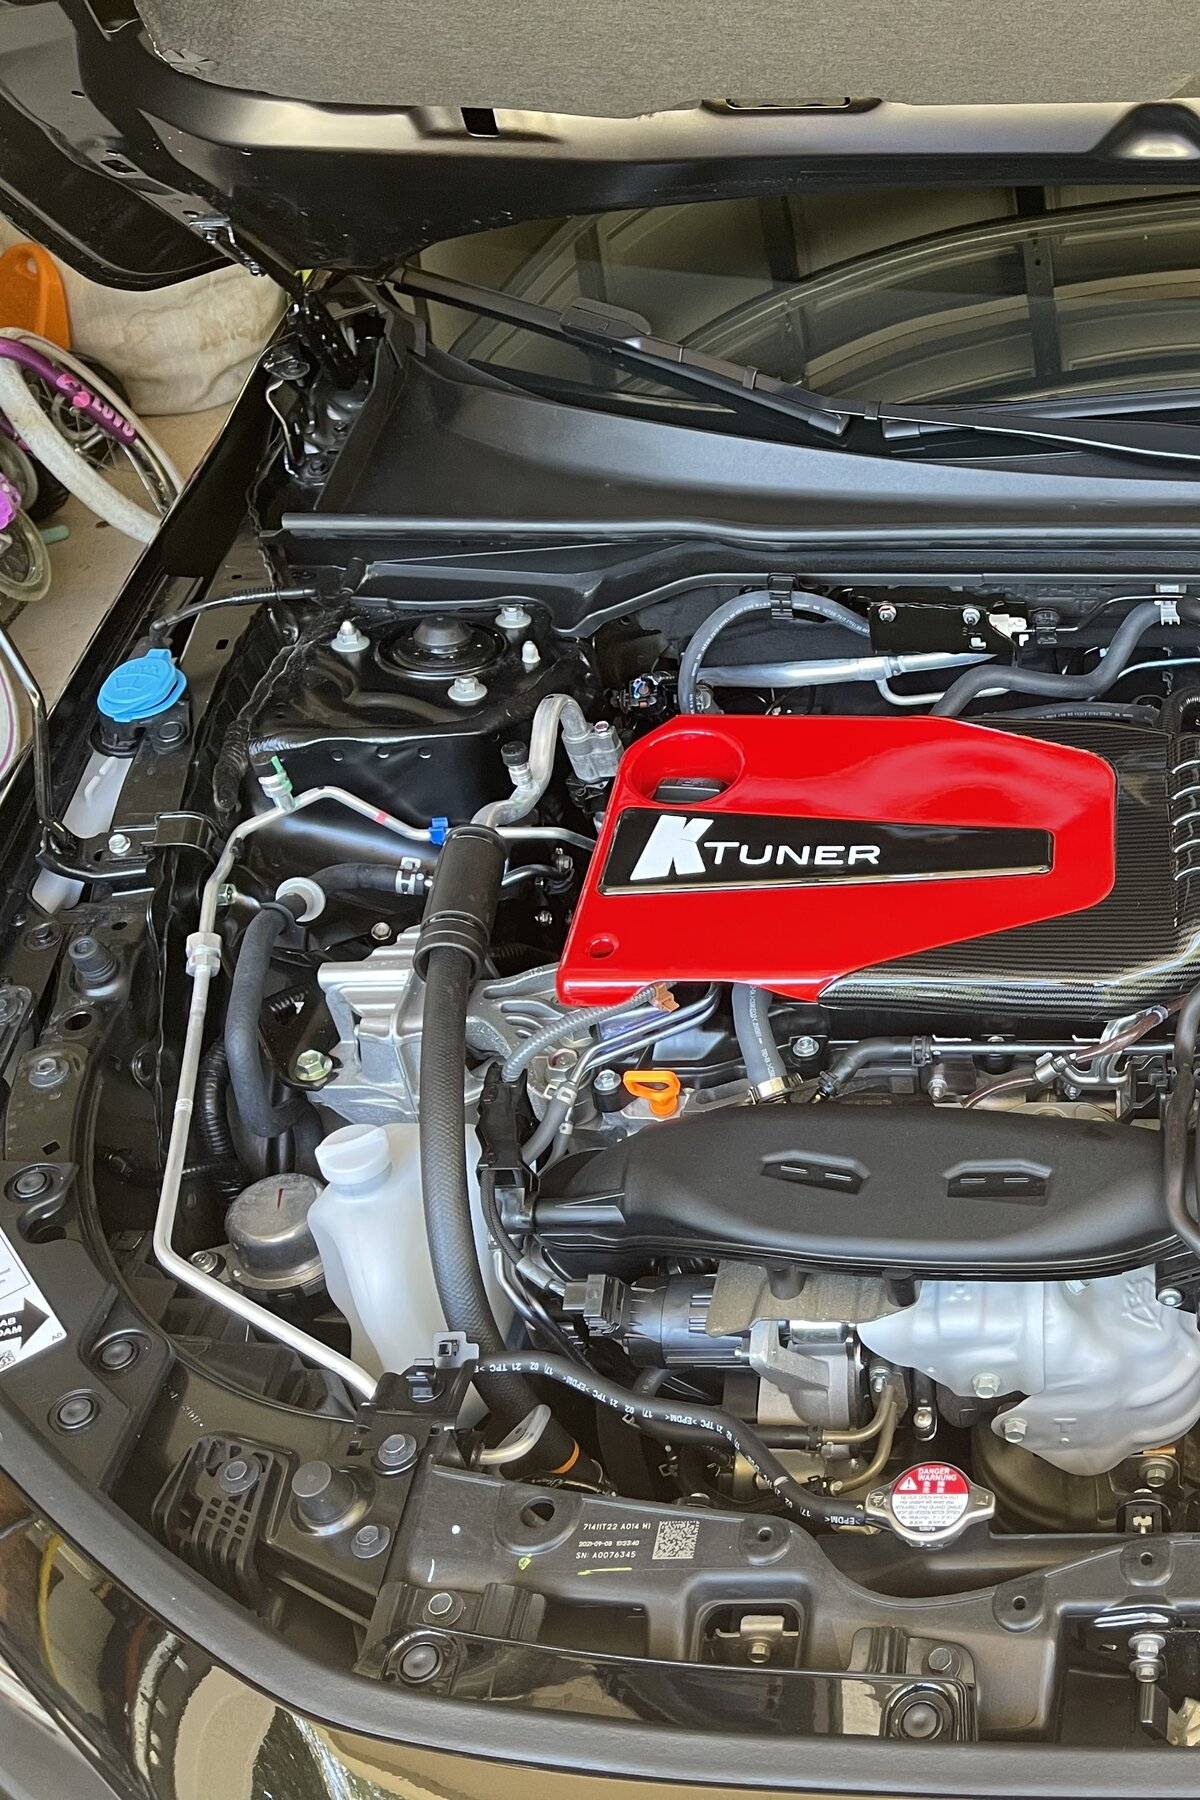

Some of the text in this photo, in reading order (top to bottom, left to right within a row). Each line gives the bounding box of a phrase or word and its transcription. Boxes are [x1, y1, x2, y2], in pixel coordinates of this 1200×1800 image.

[630, 814, 881, 881] KTUNER
[489, 1363, 508, 1372] TPC
[918, 1467, 951, 1475] DANGER
[592, 1551, 637, 1559] A0076345
